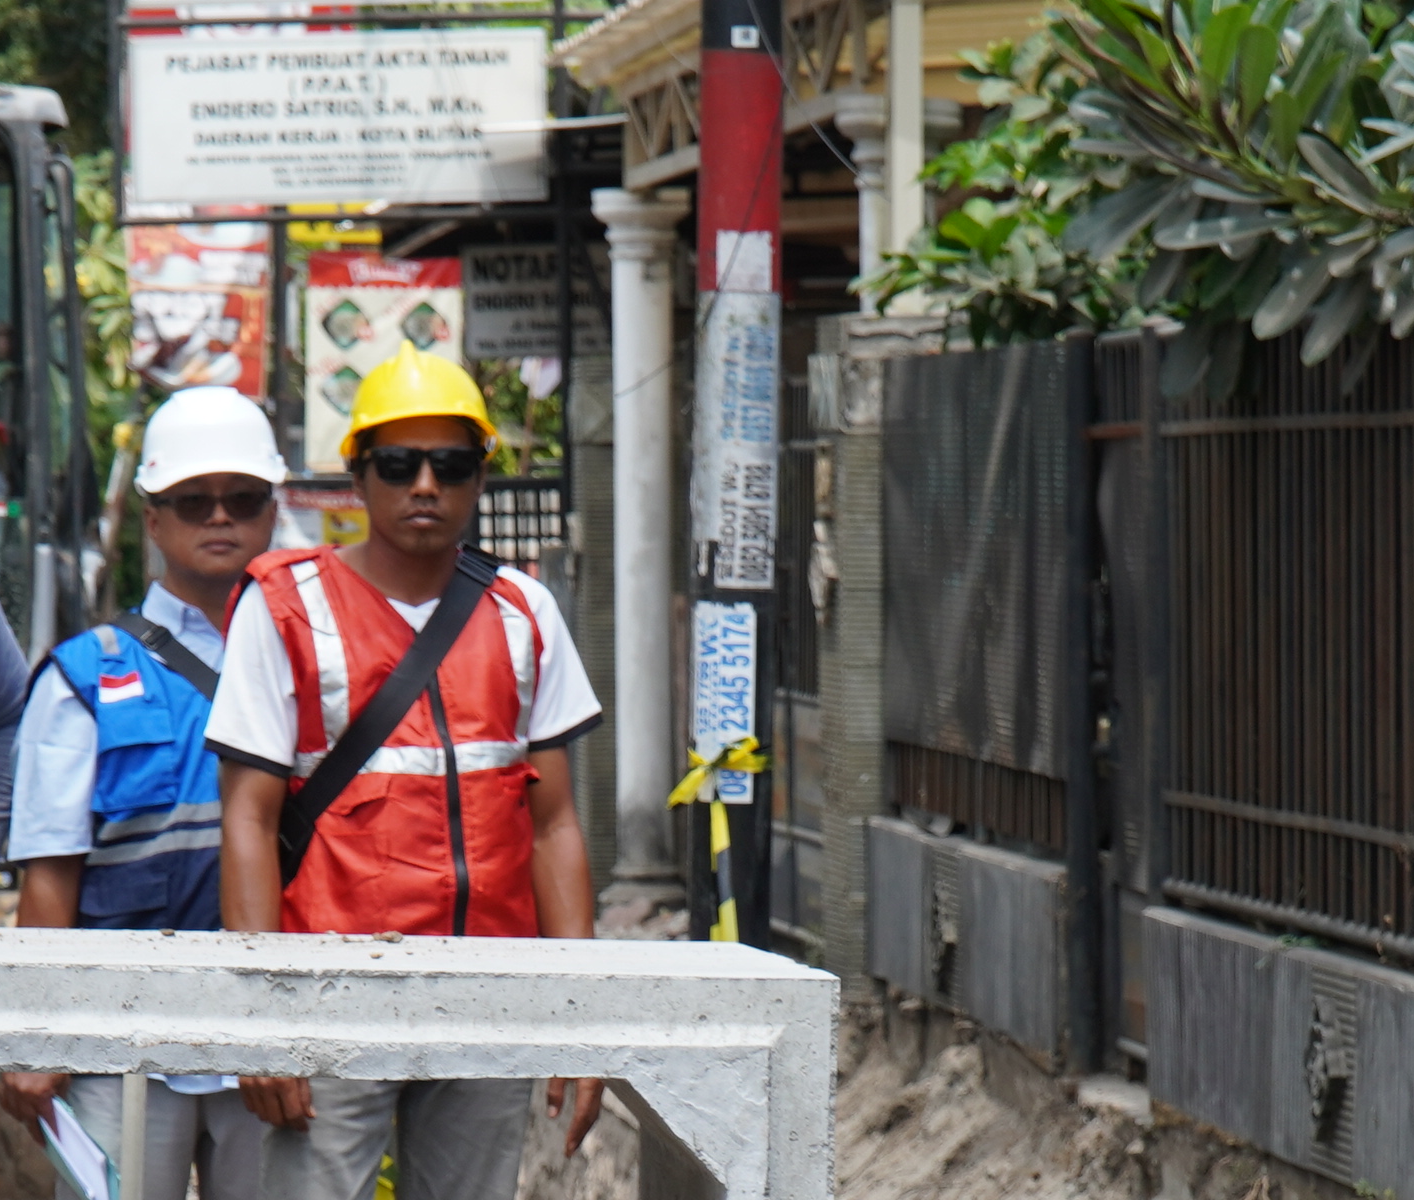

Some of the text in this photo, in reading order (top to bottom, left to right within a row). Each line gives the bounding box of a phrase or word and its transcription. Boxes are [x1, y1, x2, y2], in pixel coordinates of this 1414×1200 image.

[166, 47, 509, 74] PEJABAT PEMBUAT AKTA TANAH
[719, 676, 750, 732] 2345
